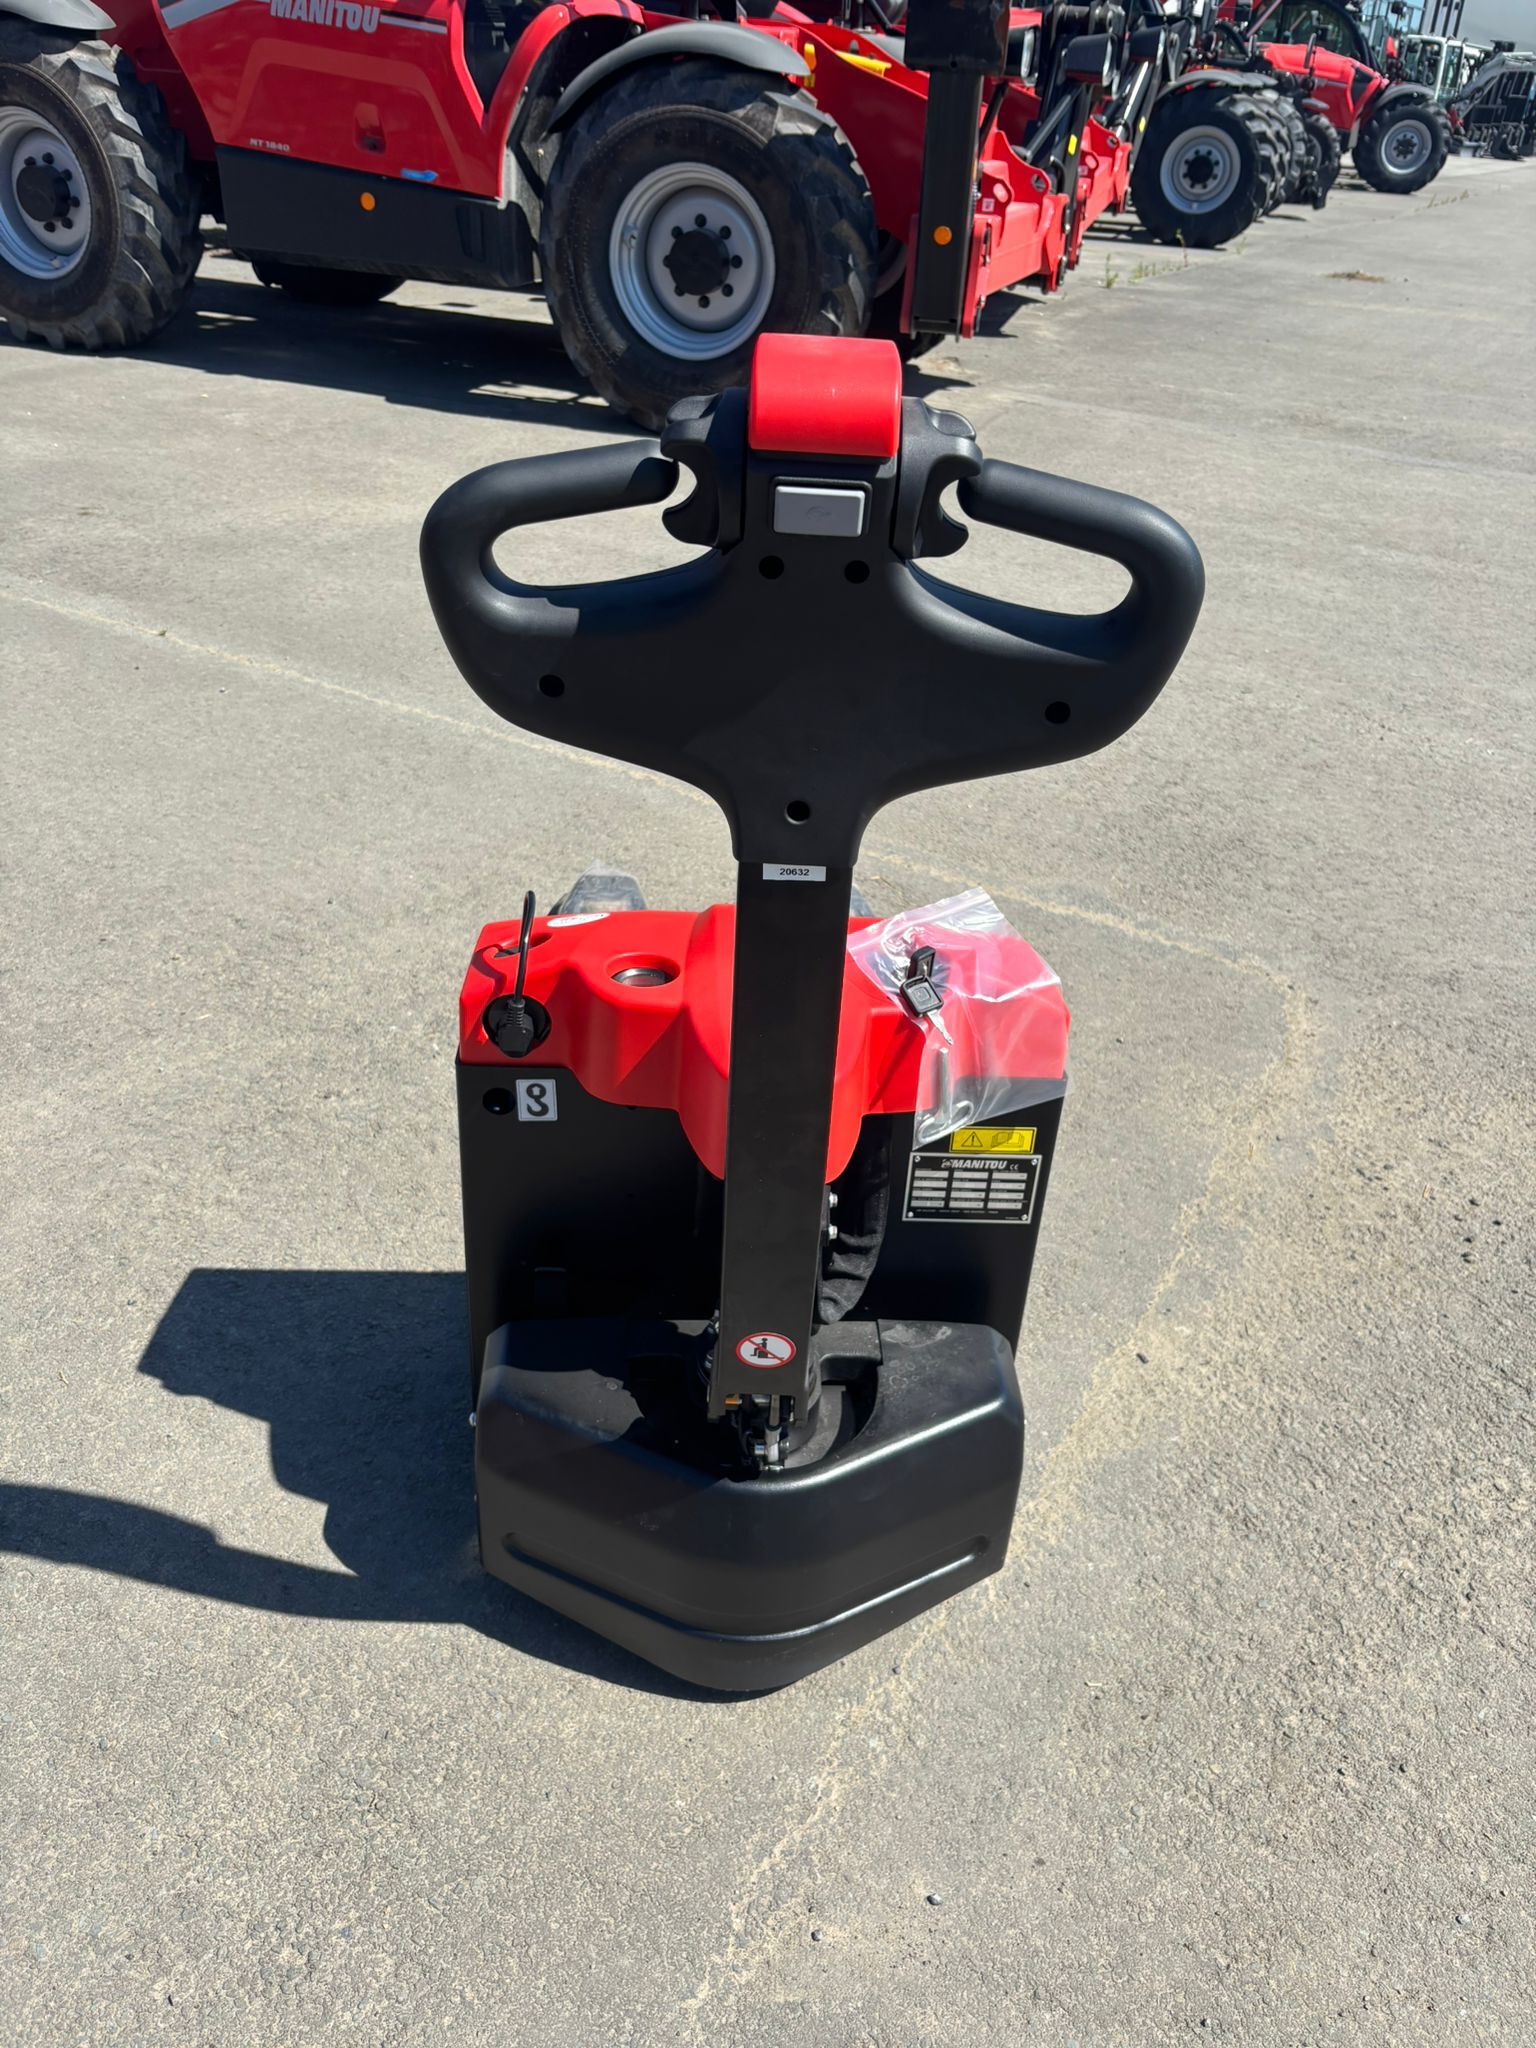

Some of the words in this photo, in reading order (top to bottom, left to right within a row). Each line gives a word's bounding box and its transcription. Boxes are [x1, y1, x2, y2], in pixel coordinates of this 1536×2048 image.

[270, 0, 381, 33] MANITOU
[779, 867, 810, 876] 20632
[950, 1159, 1008, 1170] MANITOU
